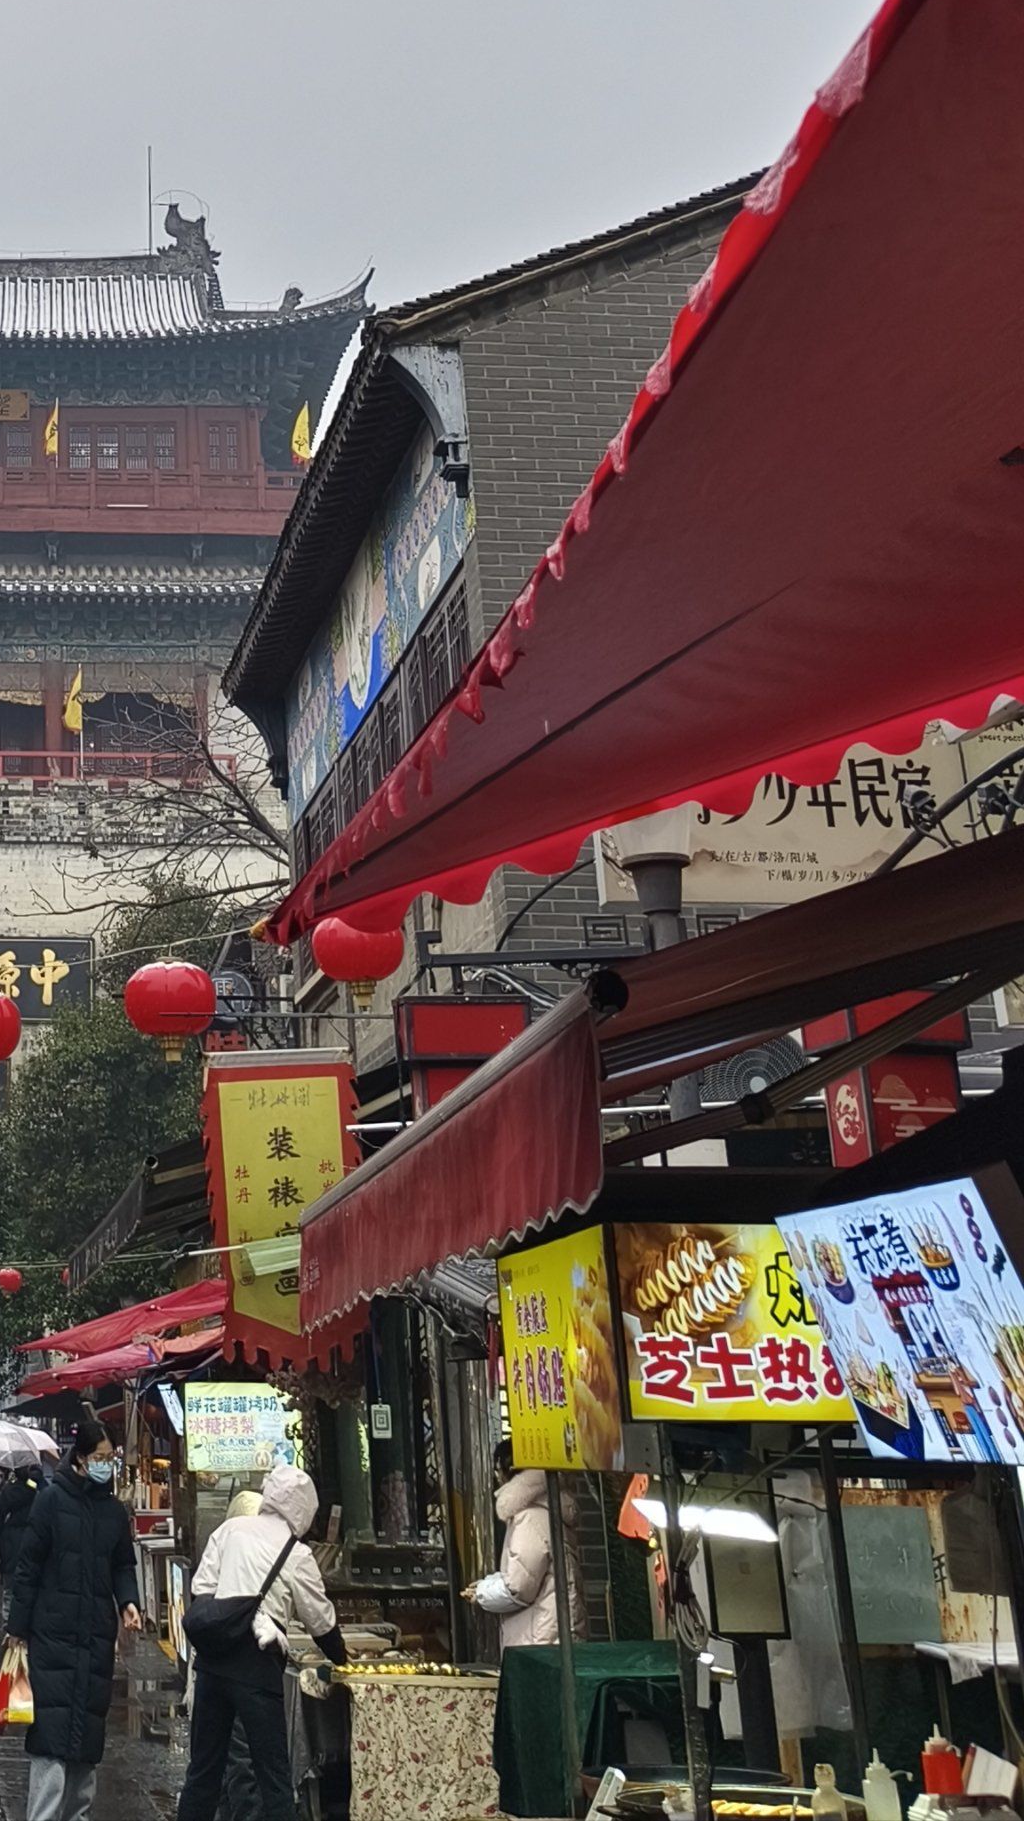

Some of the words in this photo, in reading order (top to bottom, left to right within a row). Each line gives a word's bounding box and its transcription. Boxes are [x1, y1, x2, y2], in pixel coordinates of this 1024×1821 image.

[697, 757, 931, 828] 少年民宿
[234, 1165, 252, 1204] 牡丹
[188, 1396, 277, 1413] 鲜花罐罐烤奶
